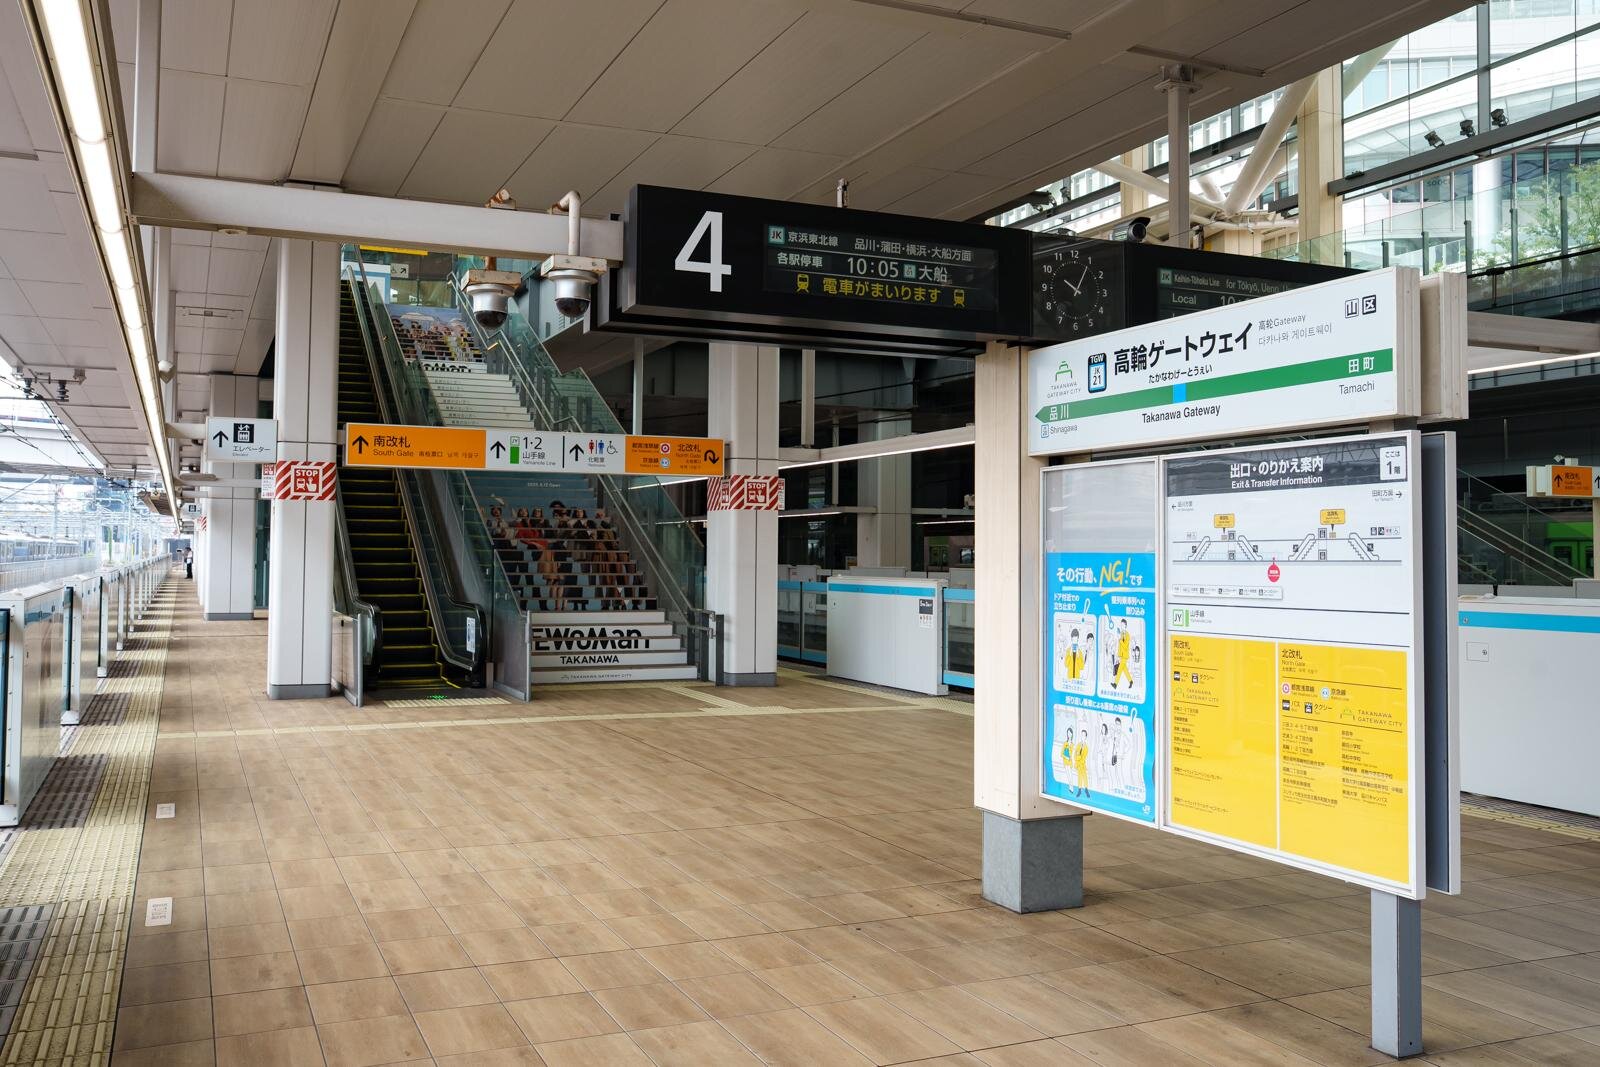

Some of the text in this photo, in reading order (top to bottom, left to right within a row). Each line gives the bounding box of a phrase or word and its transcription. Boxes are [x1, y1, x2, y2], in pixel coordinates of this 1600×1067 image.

[788, 231, 838, 247] 京浜東北線
[674, 210, 732, 293] 4
[1070, 250, 1079, 259] 12
[777, 252, 823, 267] 各駅停車
[848, 257, 899, 277] 10:05
[1043, 265, 1052, 273] 10
[919, 265, 948, 282] 大船
[1098, 271, 1104, 279] 2
[1041, 283, 1048, 291] 9
[1226, 279, 1236, 289] for
[822, 277, 942, 303] 電車がまいります
[1102, 289, 1108, 297] 3
[1172, 293, 1197, 305] Local
[1046, 301, 1052, 310] 8
[1098, 306, 1104, 314] 4
[1058, 316, 1063, 324] 7
[1088, 319, 1094, 327] 5
[1073, 322, 1079, 331] 6
[1258, 331, 1289, 346] 다카나와
[1114, 321, 1253, 375] 高輪ゲートウェイ
[1090, 354, 1104, 364] TGW
[1349, 356, 1375, 373] 田町
[1094, 367, 1100, 375] JK
[1149, 365, 1213, 384] たかなわげーとうぇい
[1092, 375, 1102, 386] 21
[1051, 382, 1077, 391] TAKANAWA
[1339, 382, 1375, 395] Tamachi
[1047, 390, 1069, 399] GATEWAY
[1049, 404, 1070, 421] 品川
[1142, 404, 1221, 424] Takanawa Gateway
[1050, 424, 1078, 436] Shinagawa
[373, 435, 411, 448] 南改札
[233, 445, 271, 453] エレベーター
[373, 449, 395, 457] South
[677, 444, 702, 453] 北改札
[523, 451, 546, 460] 山手線
[1230, 455, 1324, 479] 出口・のりかえ案内
[296, 469, 319, 477] STOP
[1231, 475, 1323, 489] Exit & Transfer Information
[1282, 648, 1303, 660] 北改札
[560, 655, 620, 665] TAKANAWA
[1314, 703, 1333, 711] タクシー
[1357, 709, 1392, 719] TAKANAWA
[1357, 717, 1403, 728] GATEWAY CITY
